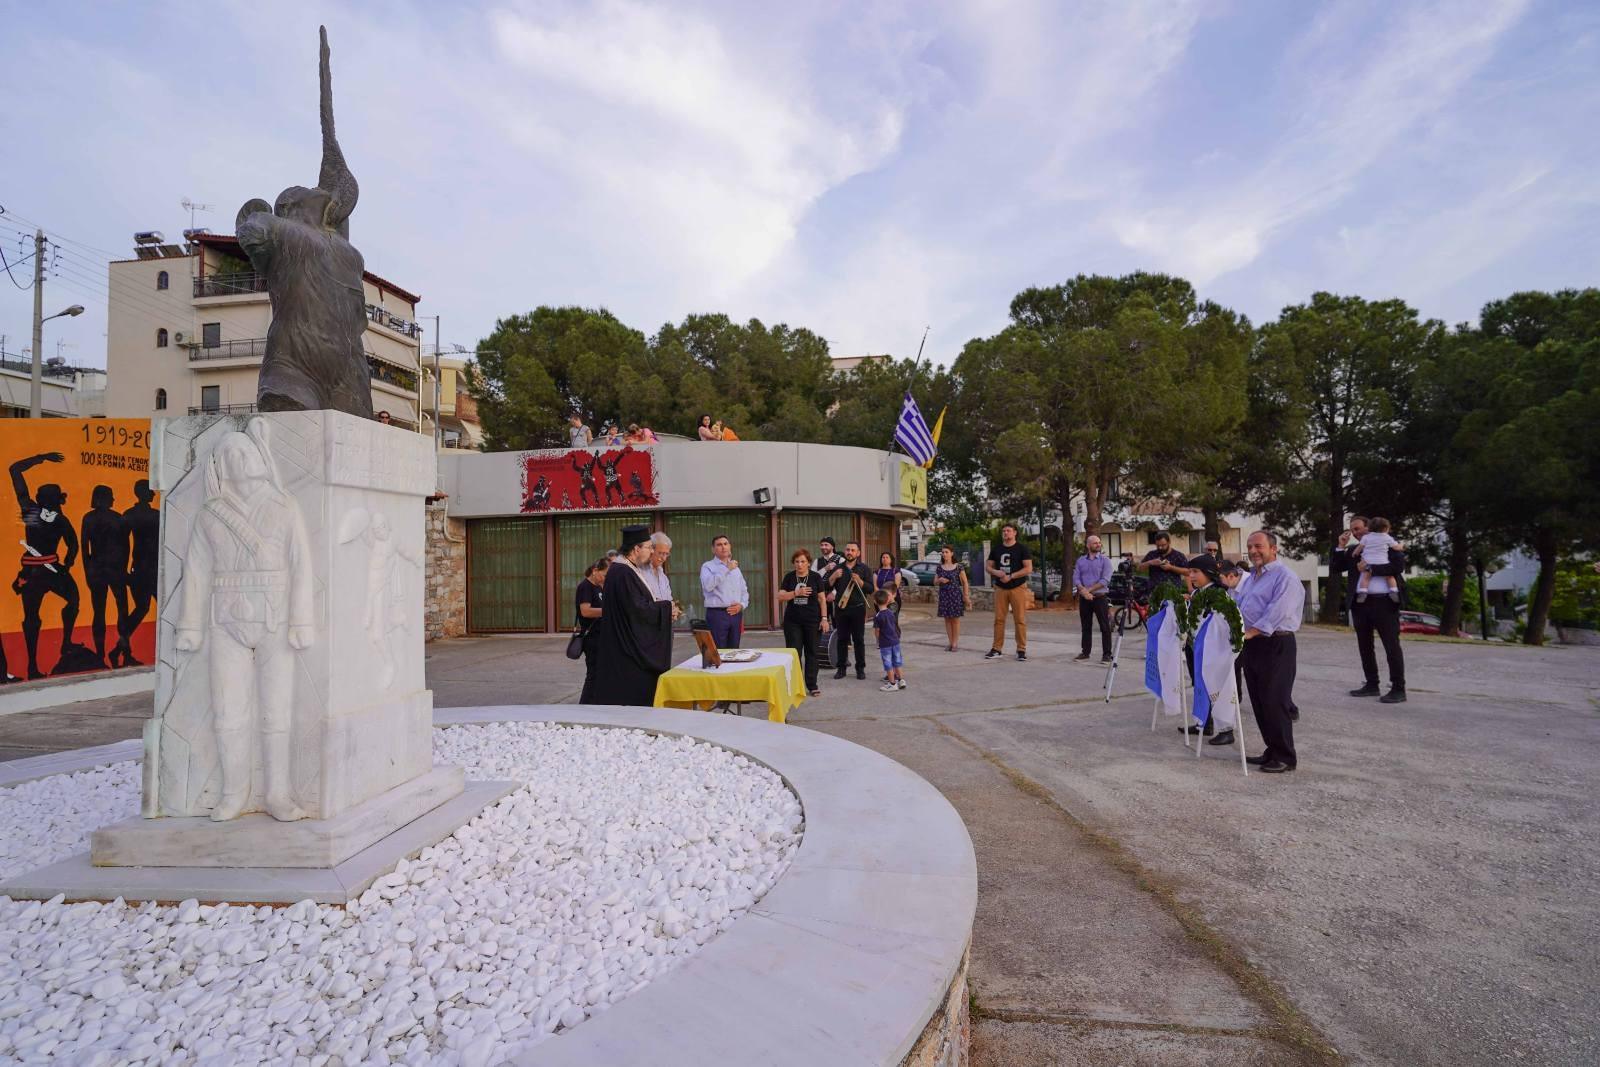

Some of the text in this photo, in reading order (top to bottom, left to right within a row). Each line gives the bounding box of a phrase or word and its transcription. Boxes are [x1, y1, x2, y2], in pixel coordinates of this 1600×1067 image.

[81, 451, 95, 465] 100
[97, 453, 125, 462] ΧΡΟΝΙΑ
[97, 460, 125, 469] ΧΡΟΝΙΑ
